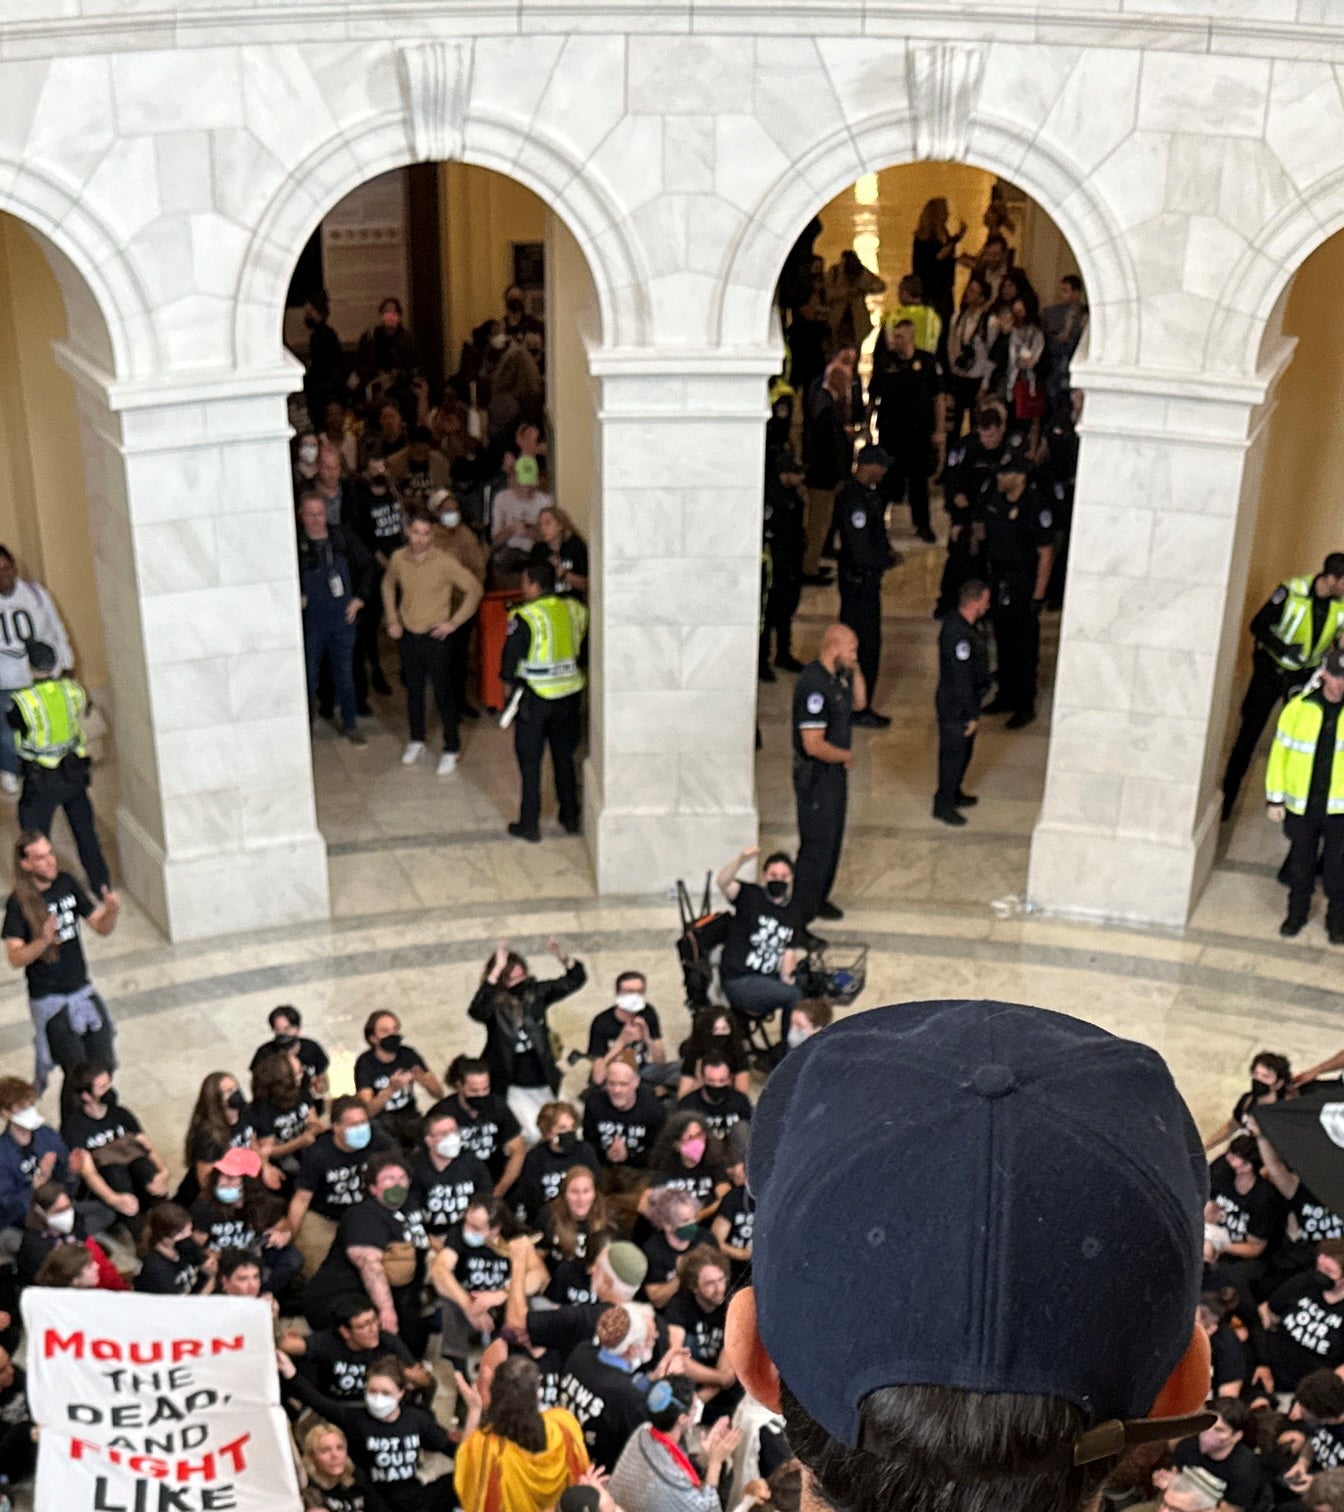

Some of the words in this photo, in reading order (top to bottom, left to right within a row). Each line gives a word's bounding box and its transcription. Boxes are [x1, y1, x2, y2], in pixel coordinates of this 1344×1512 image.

[427, 1194, 469, 1213] OUR
[43, 1328, 245, 1367] MOURN
[1282, 1312, 1332, 1356] NAME
[105, 1366, 194, 1394] THE
[561, 1372, 605, 1418] JEWS
[67, 1387, 233, 1429] DEAD,
[107, 1423, 209, 1455] AND
[367, 1436, 400, 1452] NOT
[403, 1432, 420, 1449] IN
[375, 1449, 418, 1468] OUR
